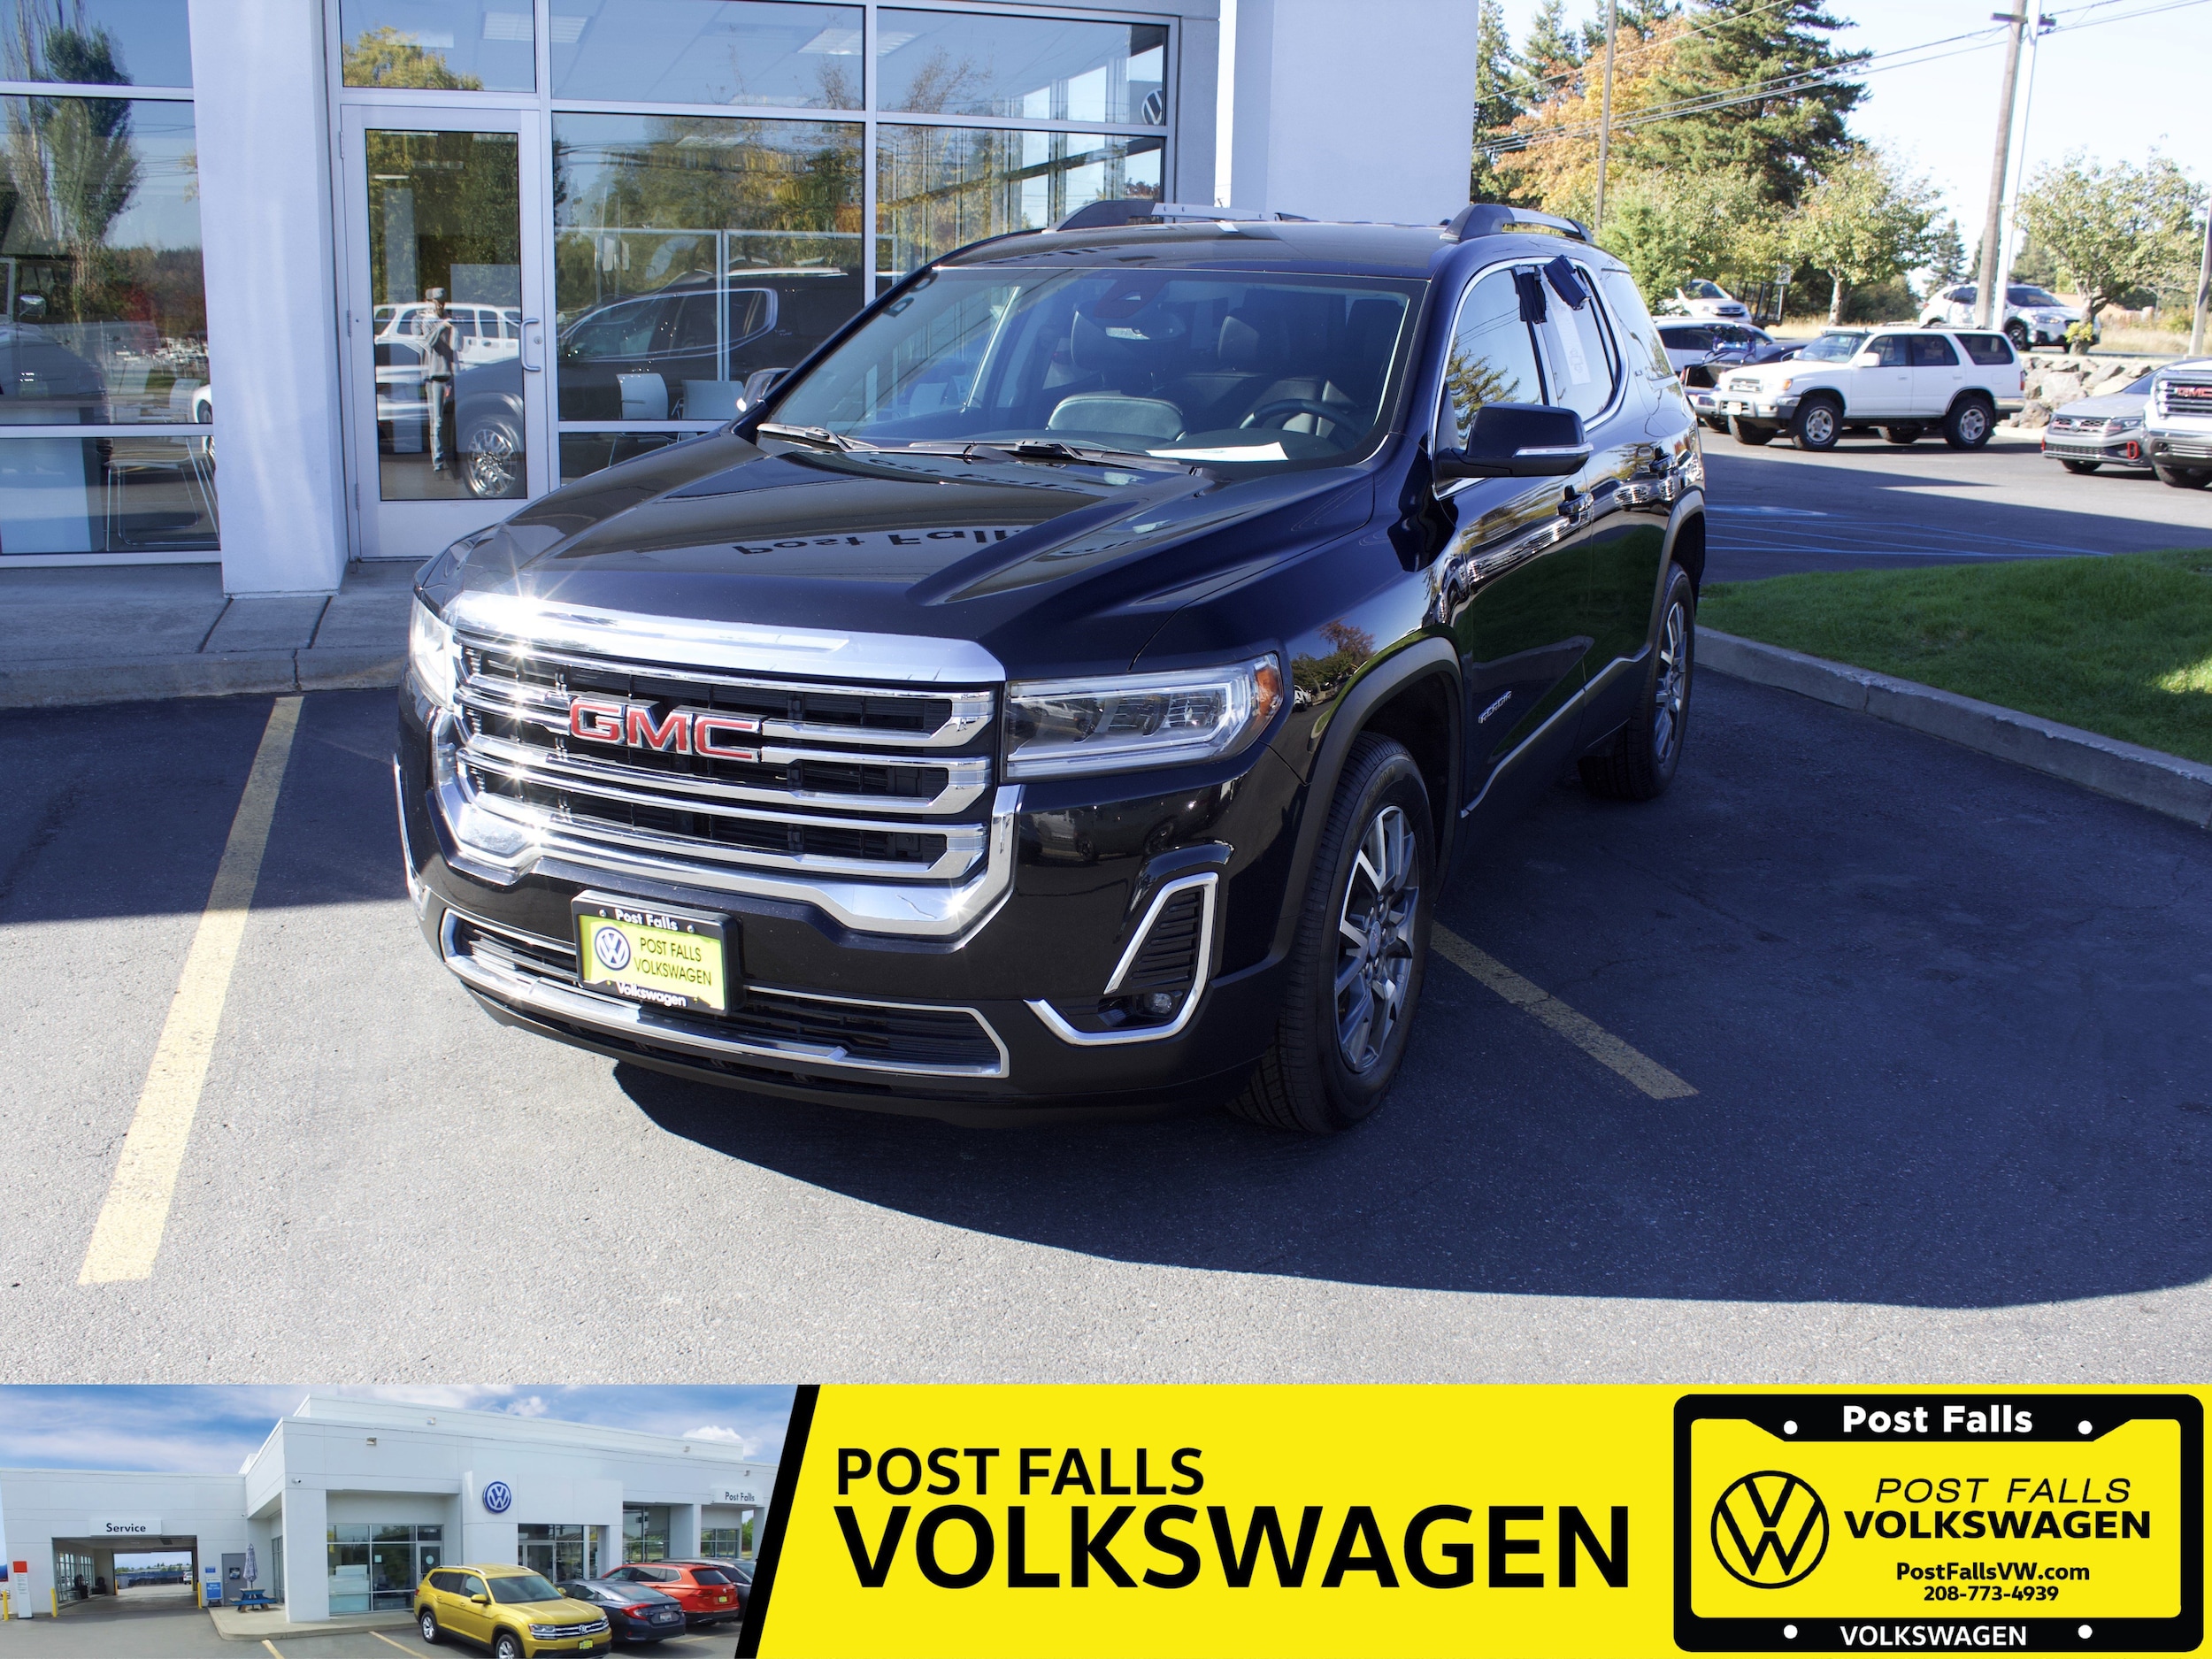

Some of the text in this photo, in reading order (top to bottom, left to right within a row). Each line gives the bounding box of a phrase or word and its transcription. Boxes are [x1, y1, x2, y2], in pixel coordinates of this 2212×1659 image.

[570, 695, 760, 764] GMC
[615, 908, 679, 931] Post Falls
[640, 937, 702, 962] POST FALLS
[634, 956, 711, 986] VOLKSWAGEN
[616, 981, 687, 1007] Volkswagen
